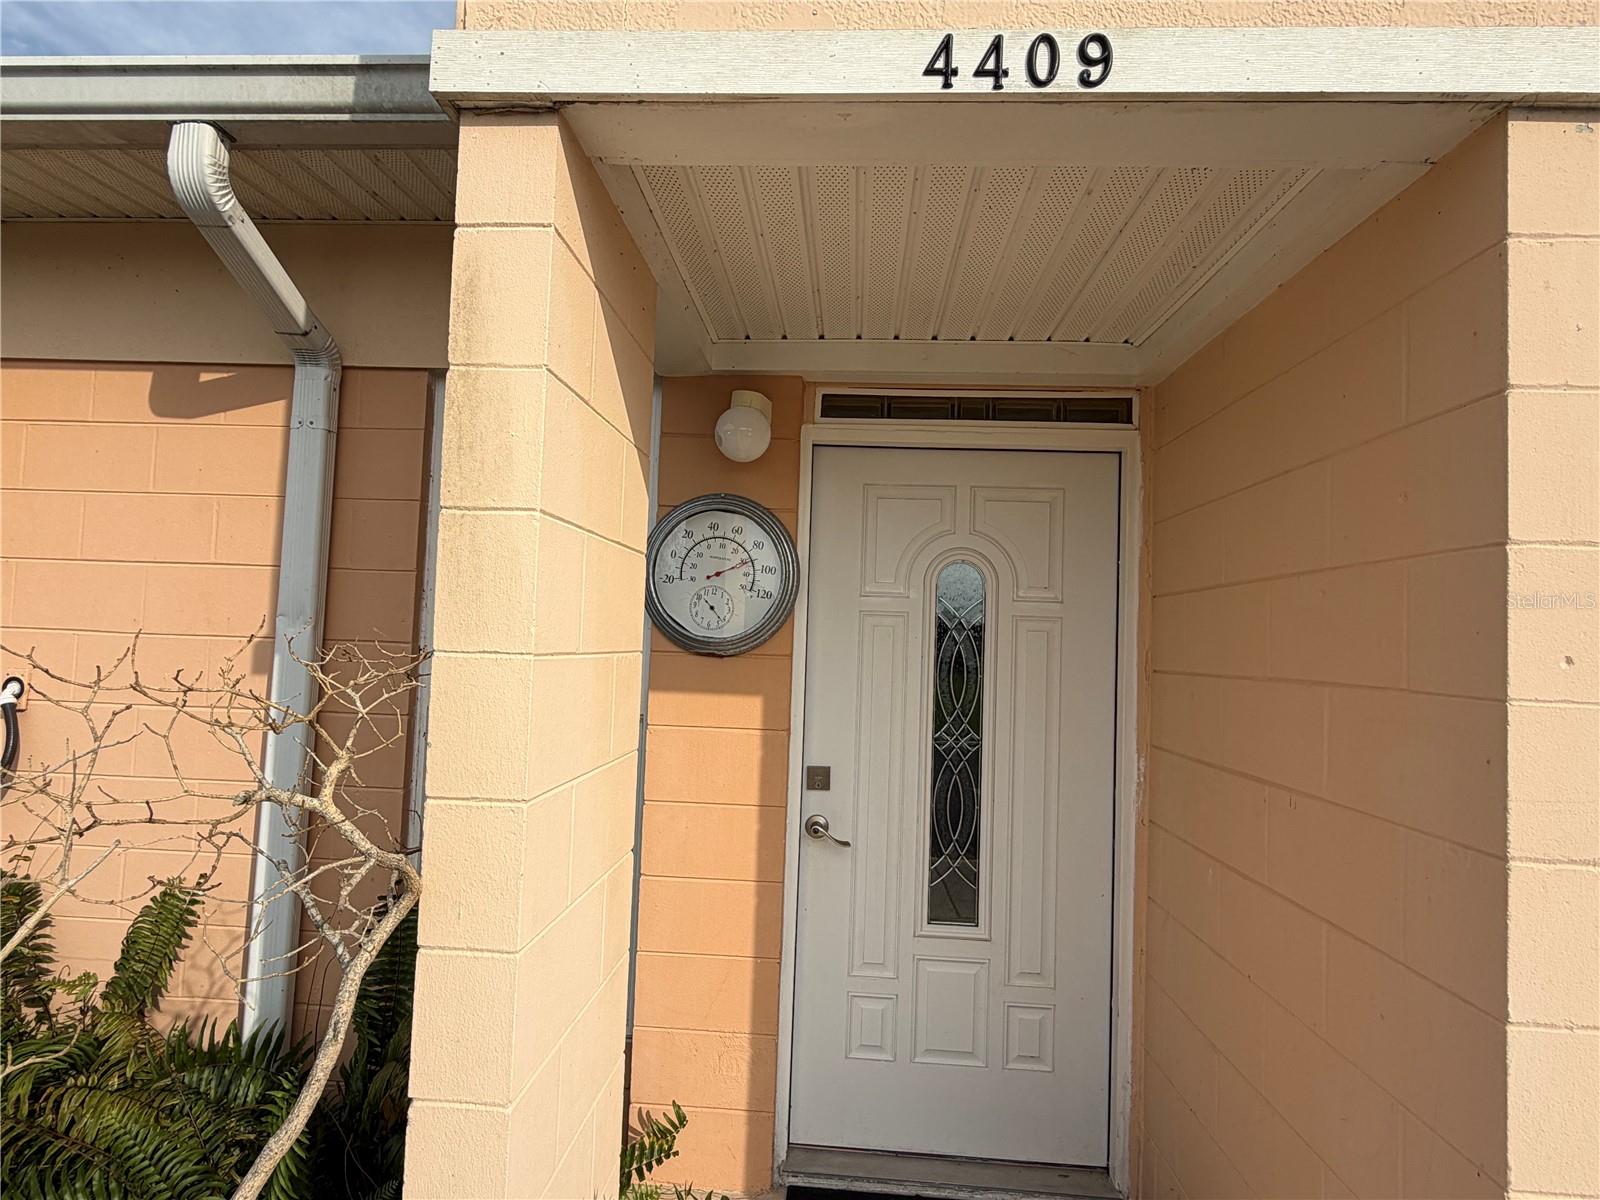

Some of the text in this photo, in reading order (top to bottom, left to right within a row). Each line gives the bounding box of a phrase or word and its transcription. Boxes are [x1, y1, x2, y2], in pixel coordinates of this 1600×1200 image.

[922, 33, 1113, 90] 4409
[707, 521, 720, 532] 40
[731, 525, 743, 536] 60
[681, 528, 694, 539] 20
[719, 542, 727, 550] 10
[752, 539, 765, 551] 80
[670, 549, 677, 559] 0
[760, 564, 777, 576] 100
[659, 574, 675, 585] -20
[756, 588, 773, 600] 120
